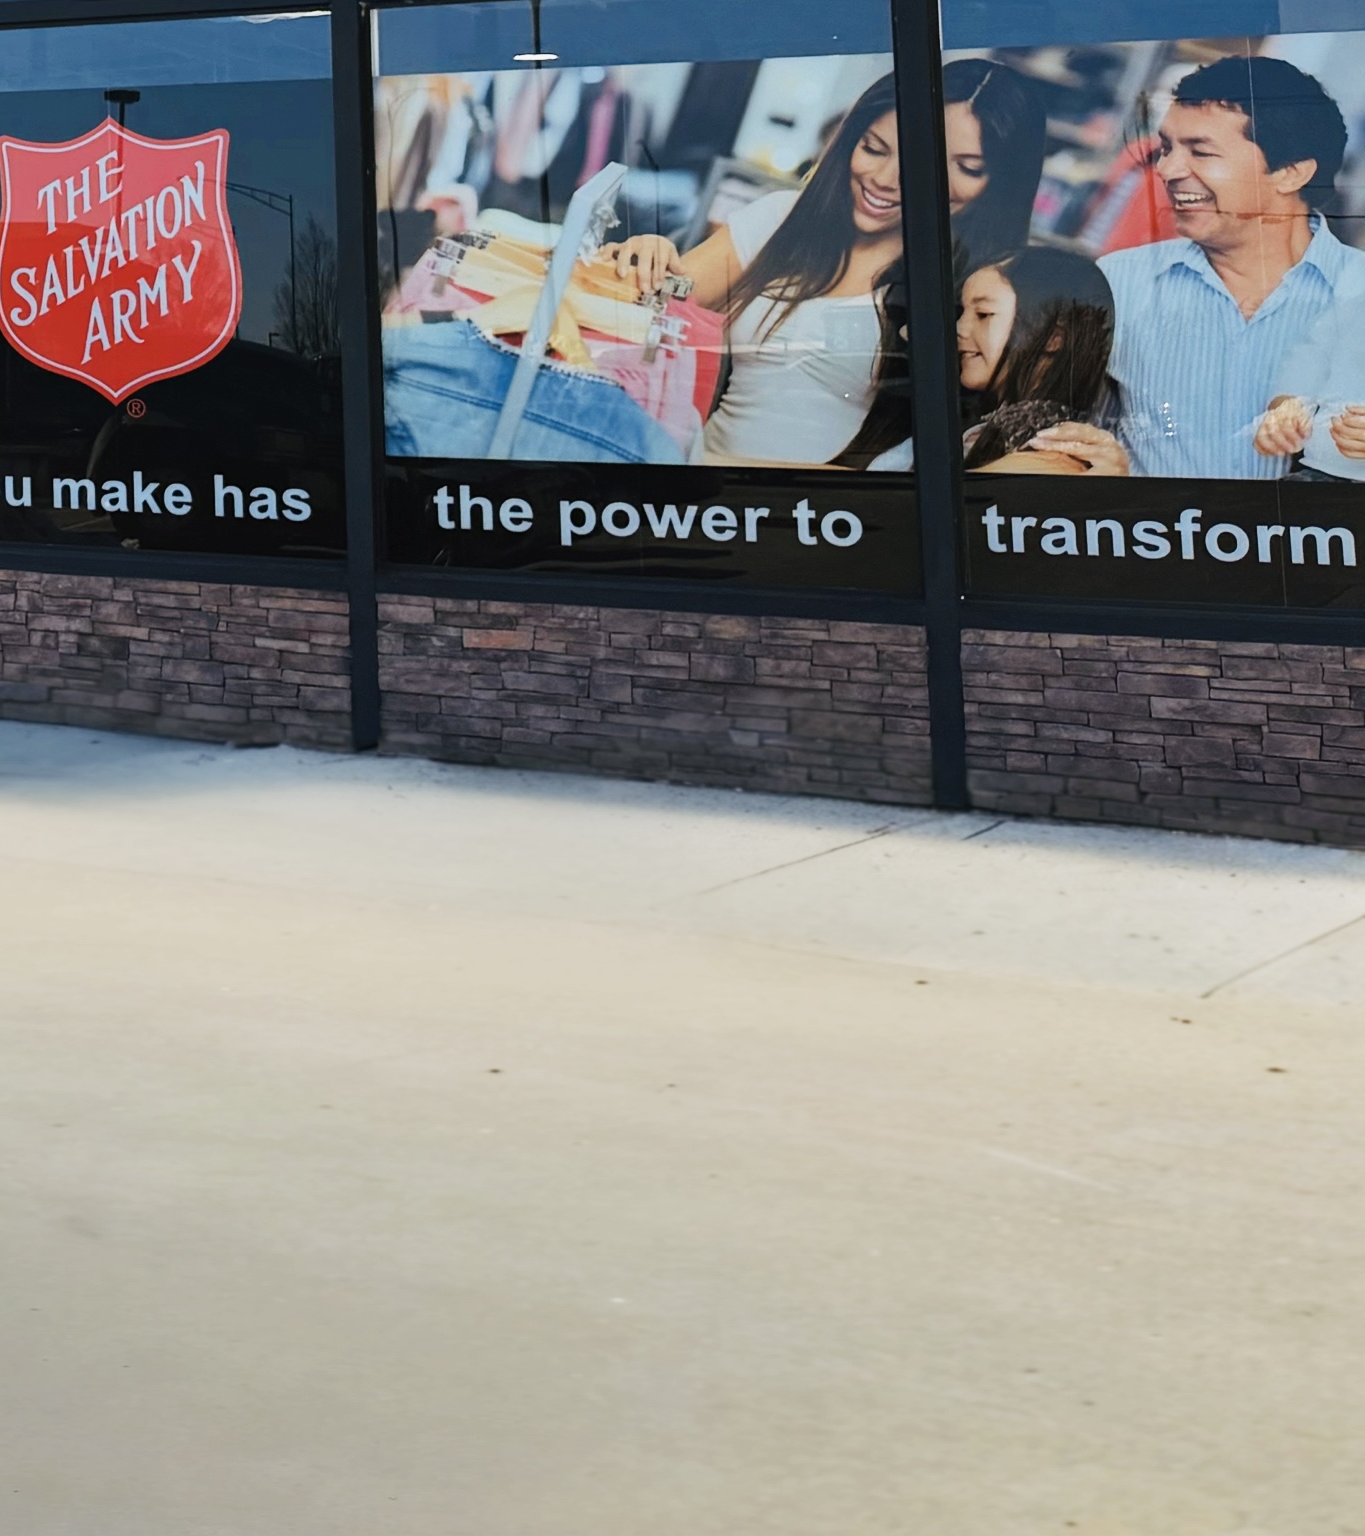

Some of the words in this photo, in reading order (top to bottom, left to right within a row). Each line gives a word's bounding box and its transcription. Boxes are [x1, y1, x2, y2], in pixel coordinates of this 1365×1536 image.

[9, 160, 207, 327] SALVATION
[37, 149, 125, 236] THE
[80, 239, 203, 365] ARMY
[52, 470, 194, 516] make
[213, 474, 313, 522] has
[432, 485, 534, 533] the
[559, 499, 770, 547] power
[792, 498, 864, 548] to
[981, 504, 1358, 568] transform
